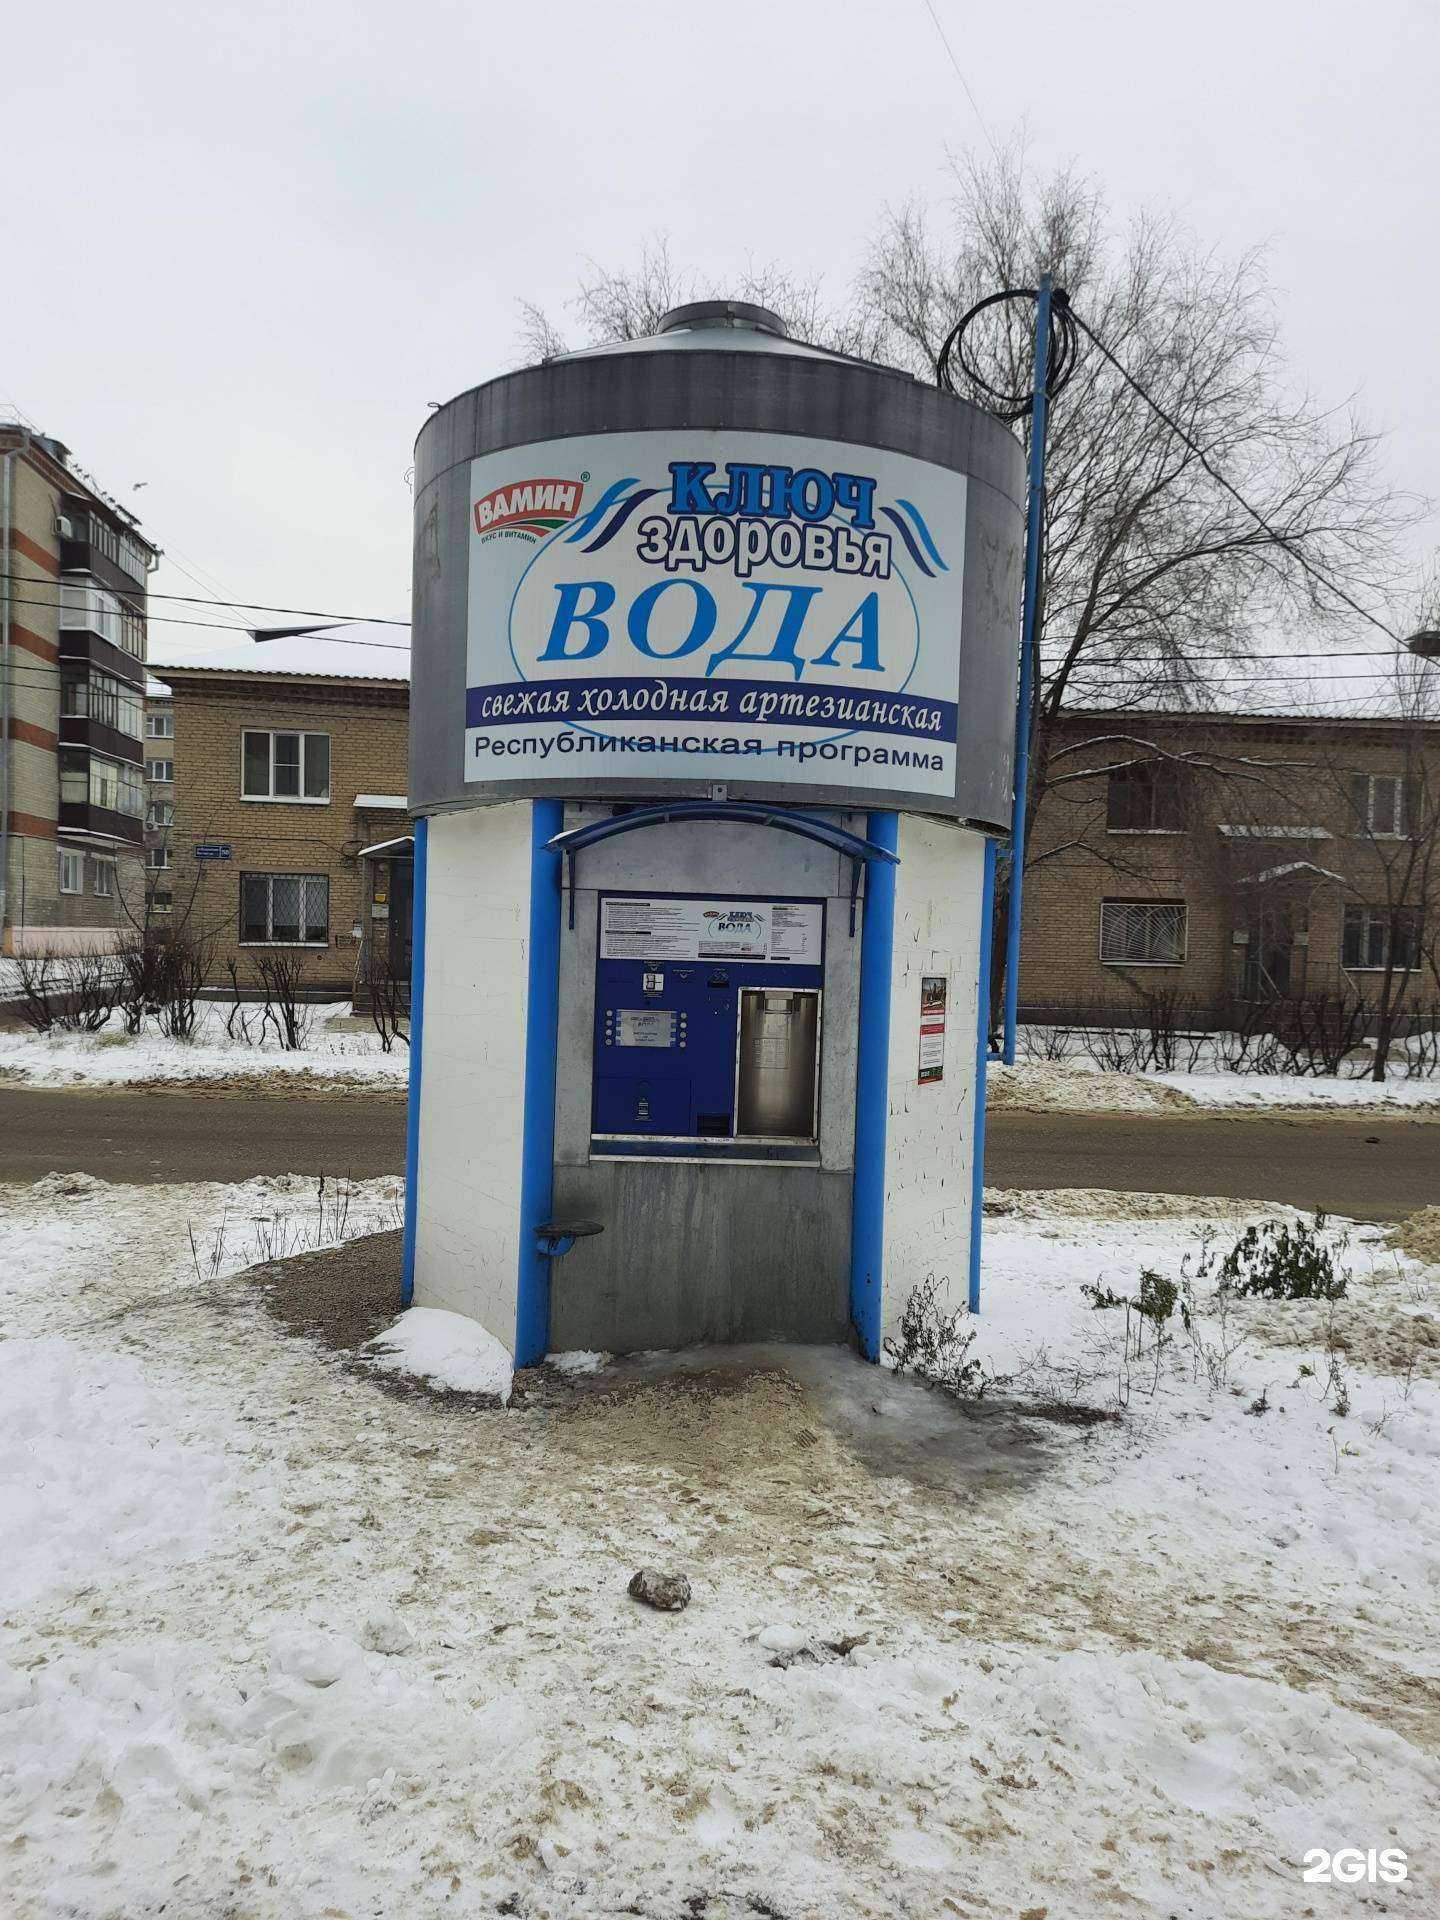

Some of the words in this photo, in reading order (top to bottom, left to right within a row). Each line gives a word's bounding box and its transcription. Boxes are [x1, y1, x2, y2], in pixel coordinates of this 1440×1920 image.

[479, 485, 577, 528] ВАМИН
[667, 462, 877, 529] КЛЮЧ
[536, 578, 885, 681] ВОДА
[481, 688, 570, 718] свежая
[577, 679, 729, 716] холодная
[739, 689, 942, 732] артезианская
[475, 731, 761, 759] Республиканская
[777, 738, 944, 772] программа
